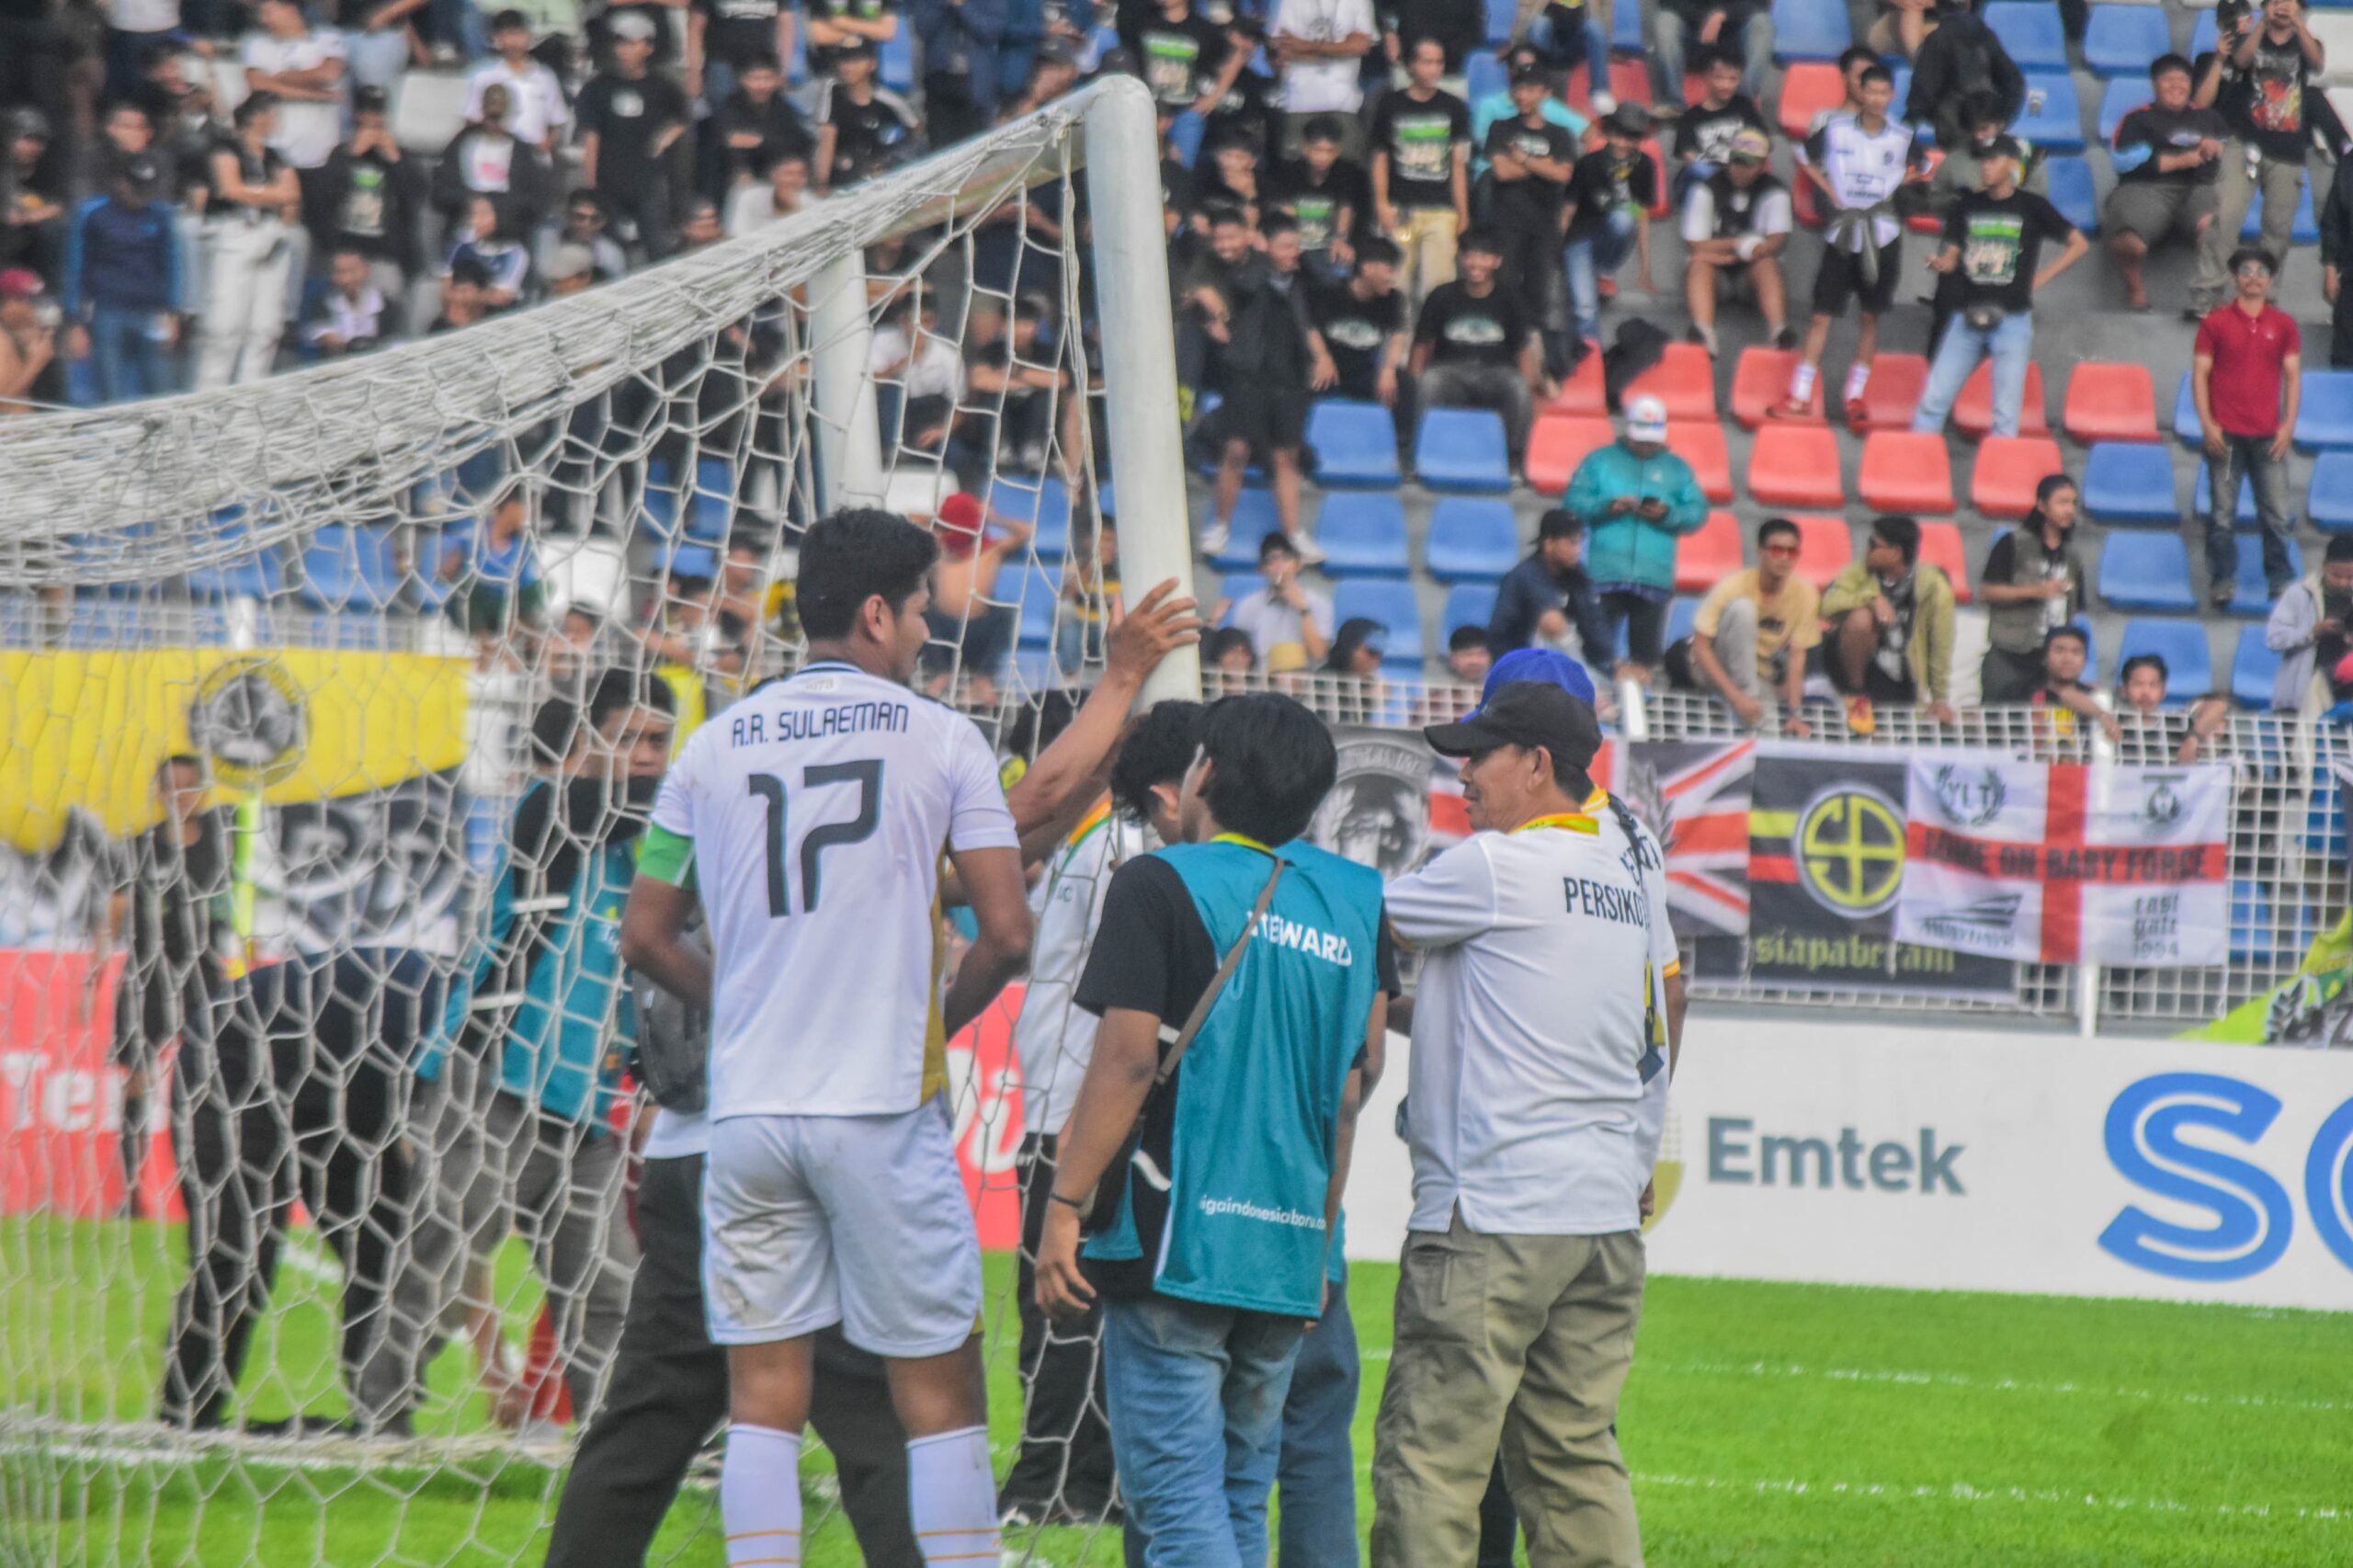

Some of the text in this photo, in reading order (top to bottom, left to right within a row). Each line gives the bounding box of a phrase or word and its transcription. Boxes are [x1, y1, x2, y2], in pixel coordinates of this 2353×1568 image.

[733, 702, 909, 748] A.R. SULAEMAN
[748, 758, 885, 918] 17
[1563, 877, 1651, 930] PERSIKO
[1708, 1116, 1967, 1196] Emtek
